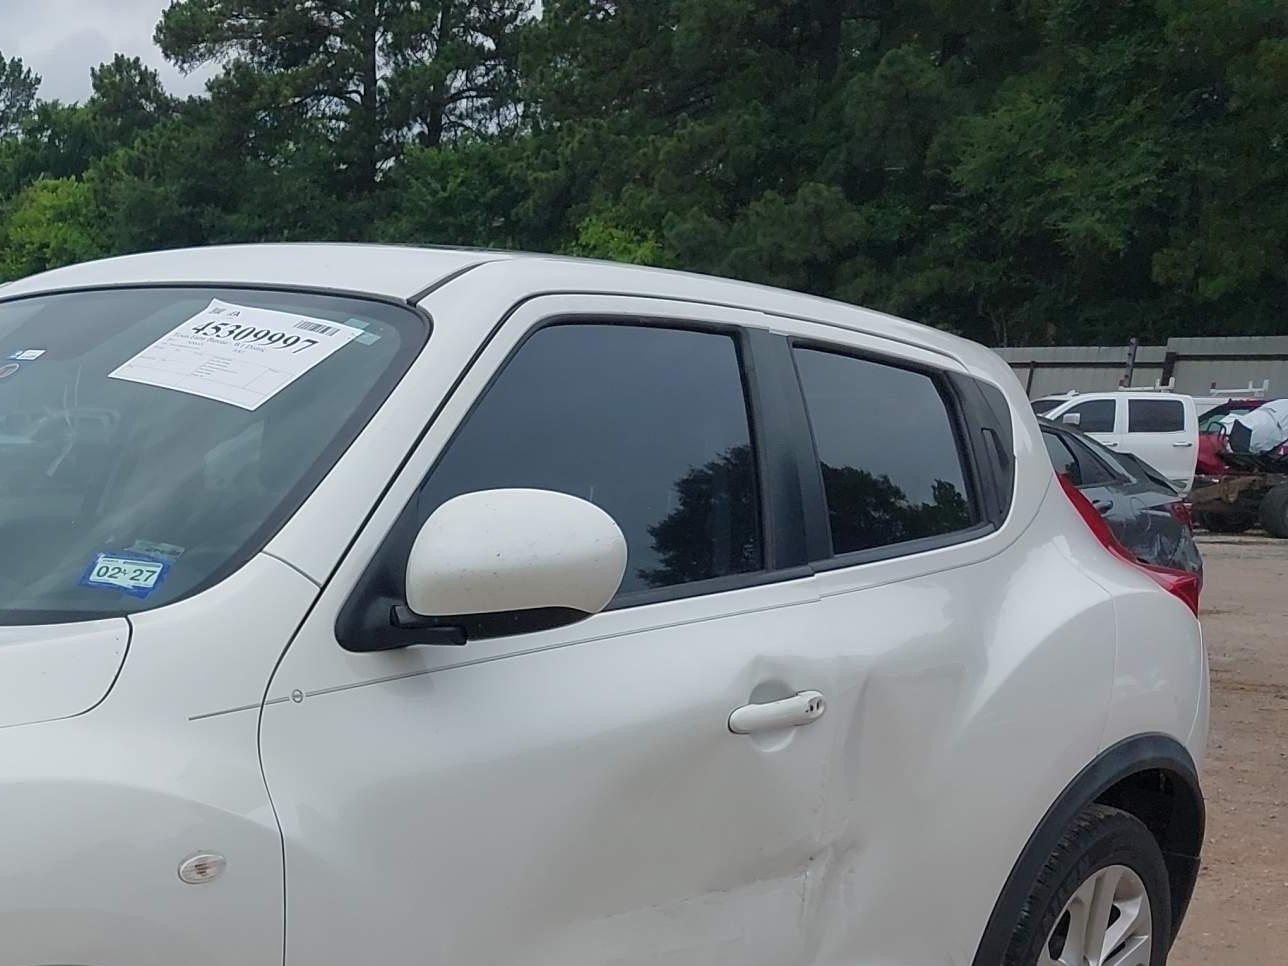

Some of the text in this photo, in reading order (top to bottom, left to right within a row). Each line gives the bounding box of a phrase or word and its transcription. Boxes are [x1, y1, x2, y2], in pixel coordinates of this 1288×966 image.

[191, 320, 320, 354] 45309997
[96, 565, 157, 582] 02 27
